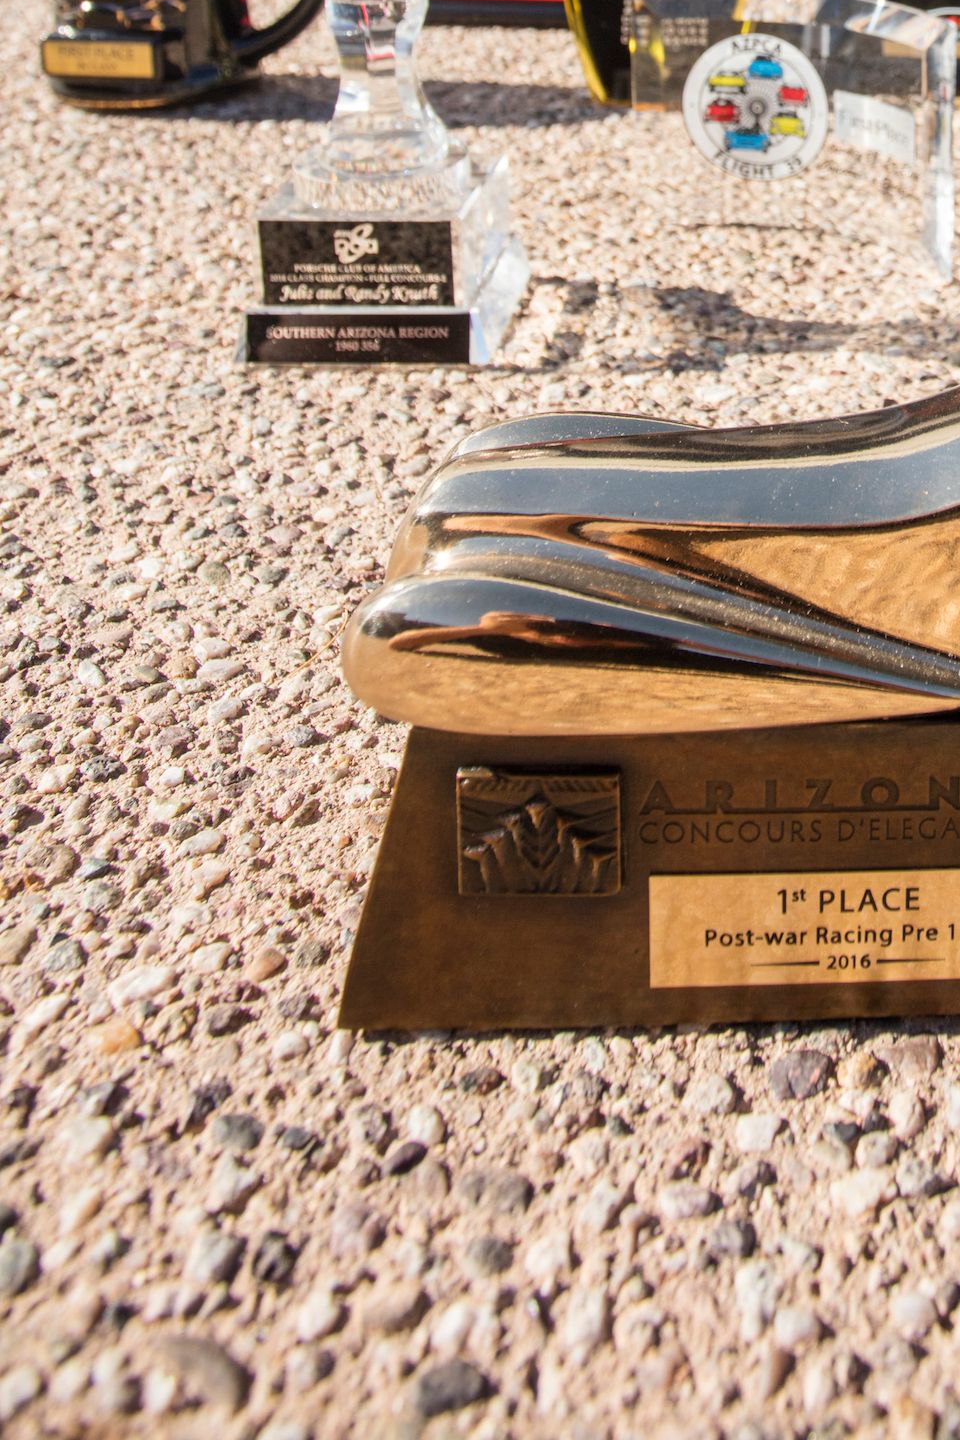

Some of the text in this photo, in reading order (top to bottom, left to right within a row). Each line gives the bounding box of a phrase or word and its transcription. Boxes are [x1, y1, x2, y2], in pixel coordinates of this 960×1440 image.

[363, 263, 376, 273] OF
[315, 284, 346, 300] and
[344, 284, 390, 305] Randy
[266, 326, 449, 339] SOUTHERN ARIZONA REGION
[639, 817, 823, 846] CONCOURS
[776, 887, 922, 915] 1st PLACE
[704, 927, 808, 948] Post-war
[815, 924, 895, 948] Racing
[901, 923, 939, 942] Pre
[827, 954, 872, 970] 2016
